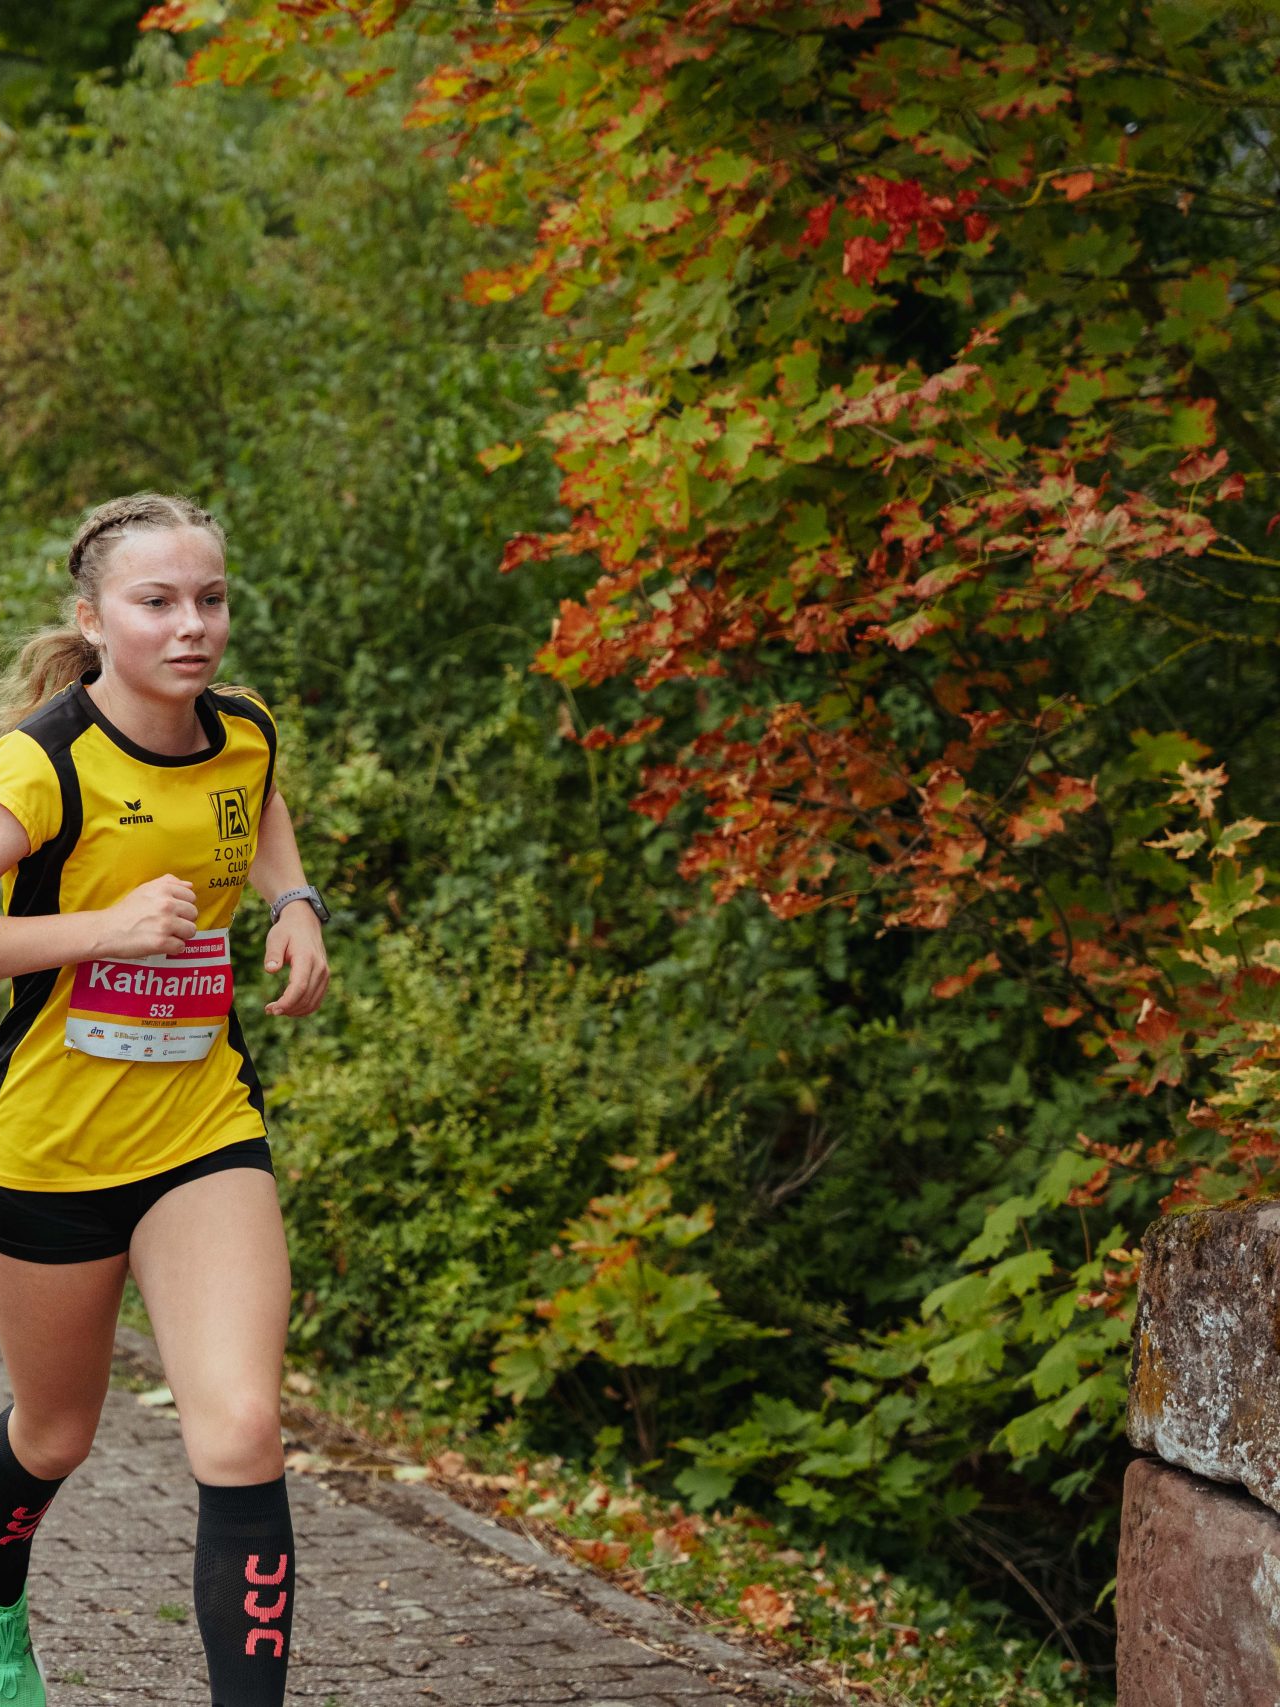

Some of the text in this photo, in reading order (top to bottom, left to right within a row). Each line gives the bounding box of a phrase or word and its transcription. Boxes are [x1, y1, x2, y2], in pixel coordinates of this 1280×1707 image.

[119, 814, 154, 825] erima
[227, 860, 248, 873] CLUB
[89, 962, 226, 997] Katharina
[149, 1003, 175, 1018] 532
[90, 1026, 104, 1035] dm
